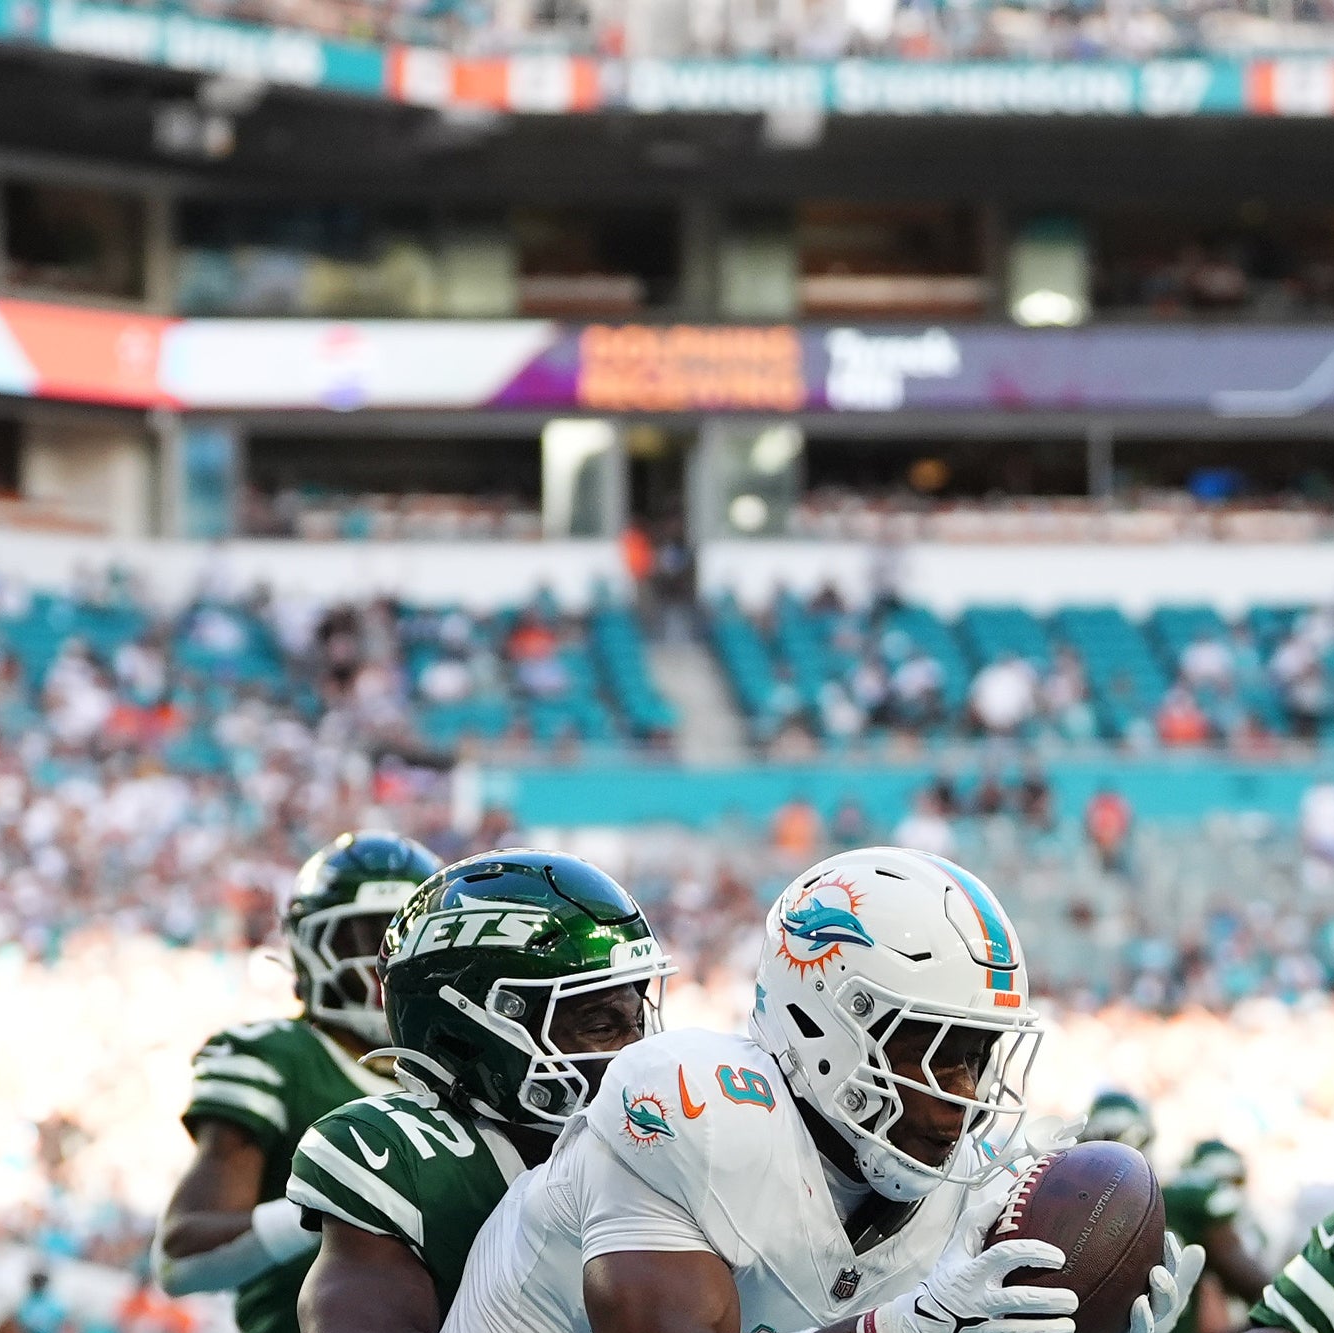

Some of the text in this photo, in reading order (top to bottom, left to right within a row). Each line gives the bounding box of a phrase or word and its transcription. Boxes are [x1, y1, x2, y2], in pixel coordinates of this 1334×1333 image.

[386, 905, 551, 968] JETS
[630, 943, 654, 958] NY
[1063, 1225, 1093, 1275] NATIONAL
[1088, 1179, 1119, 1225] FOOTBALL
